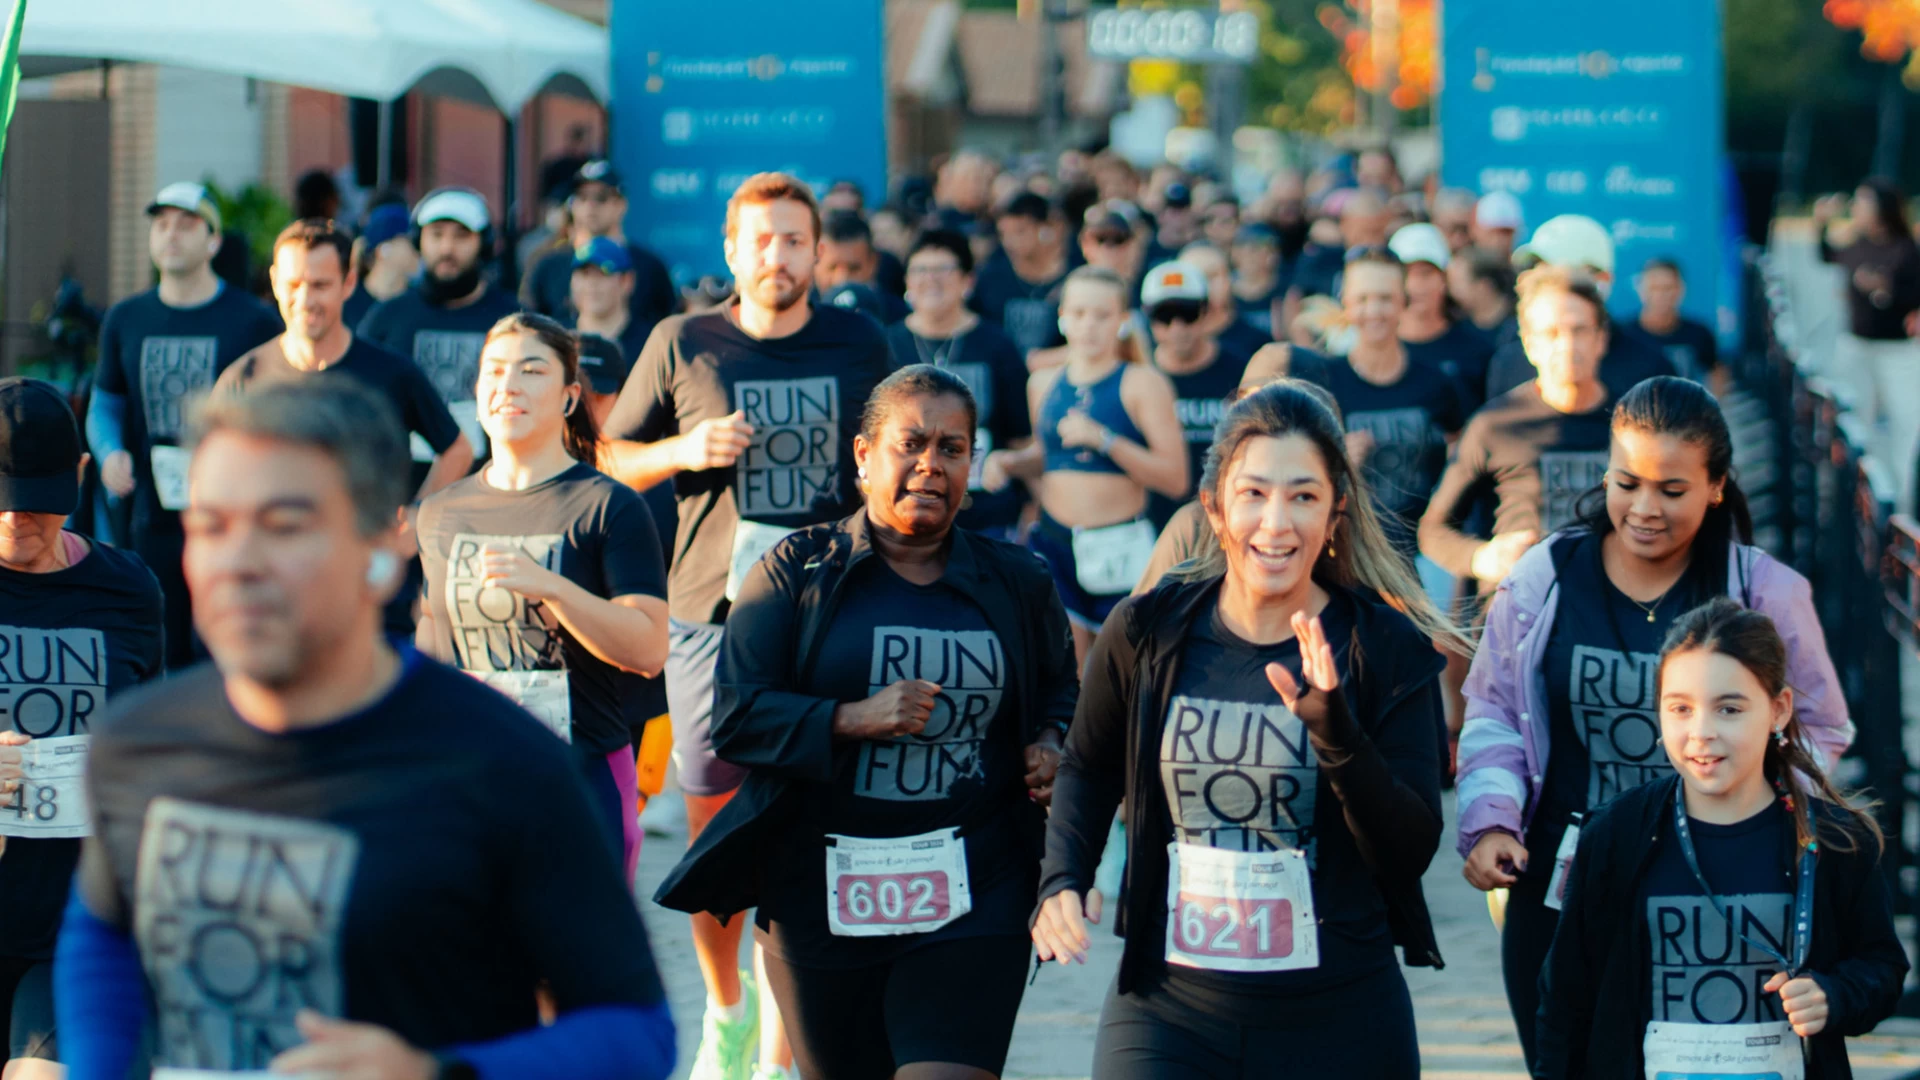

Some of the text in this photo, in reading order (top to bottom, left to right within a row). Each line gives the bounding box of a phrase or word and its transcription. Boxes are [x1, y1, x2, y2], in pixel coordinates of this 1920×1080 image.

[145, 339, 210, 371] RUN
[742, 383, 832, 426] RUN
[745, 426, 829, 466] FOR
[745, 468, 836, 509] FUN
[455, 540, 554, 577] RN
[454, 581, 548, 625] FOR
[463, 626, 563, 672] FUN
[880, 634, 998, 690] RUN
[905, 692, 990, 742] OR
[1170, 705, 1308, 768] RUN
[1582, 709, 1671, 763] FO
[864, 744, 981, 797] FUN
[3, 783, 58, 821] 48
[1172, 768, 1301, 826] FOR
[157, 818, 344, 931] RUN
[847, 877, 936, 920] 602
[1181, 901, 1271, 953] 621
[1657, 904, 1791, 966] RUN
[152, 914, 320, 1012] FOR
[1662, 969, 1780, 1023] FOR
